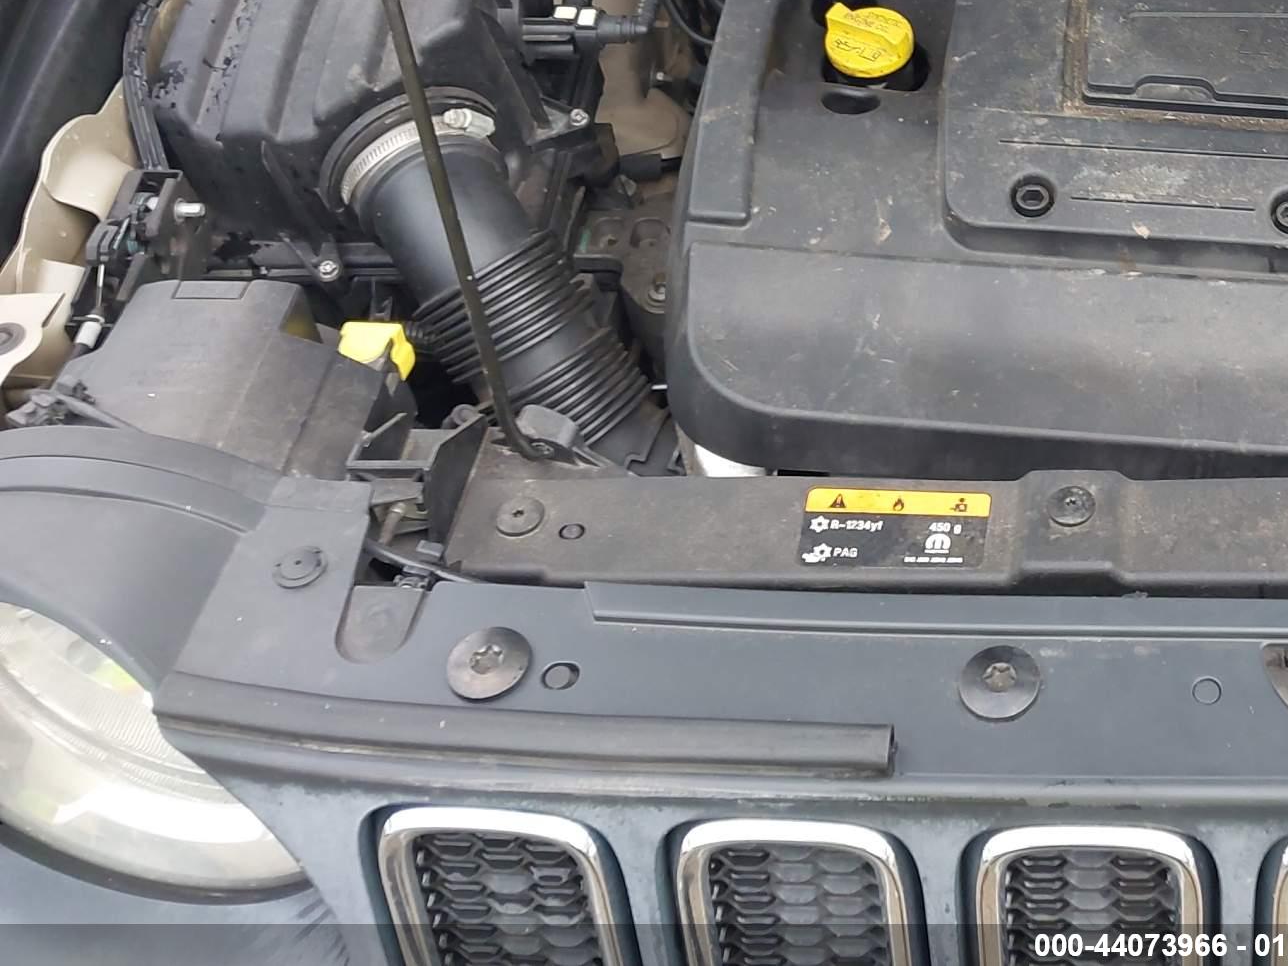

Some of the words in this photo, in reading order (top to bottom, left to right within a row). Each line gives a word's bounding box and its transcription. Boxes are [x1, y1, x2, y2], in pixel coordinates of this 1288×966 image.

[830, 519, 883, 532] R-1234yf
[929, 522, 951, 532] 450
[953, 524, 962, 534] g
[833, 547, 858, 558] PAG
